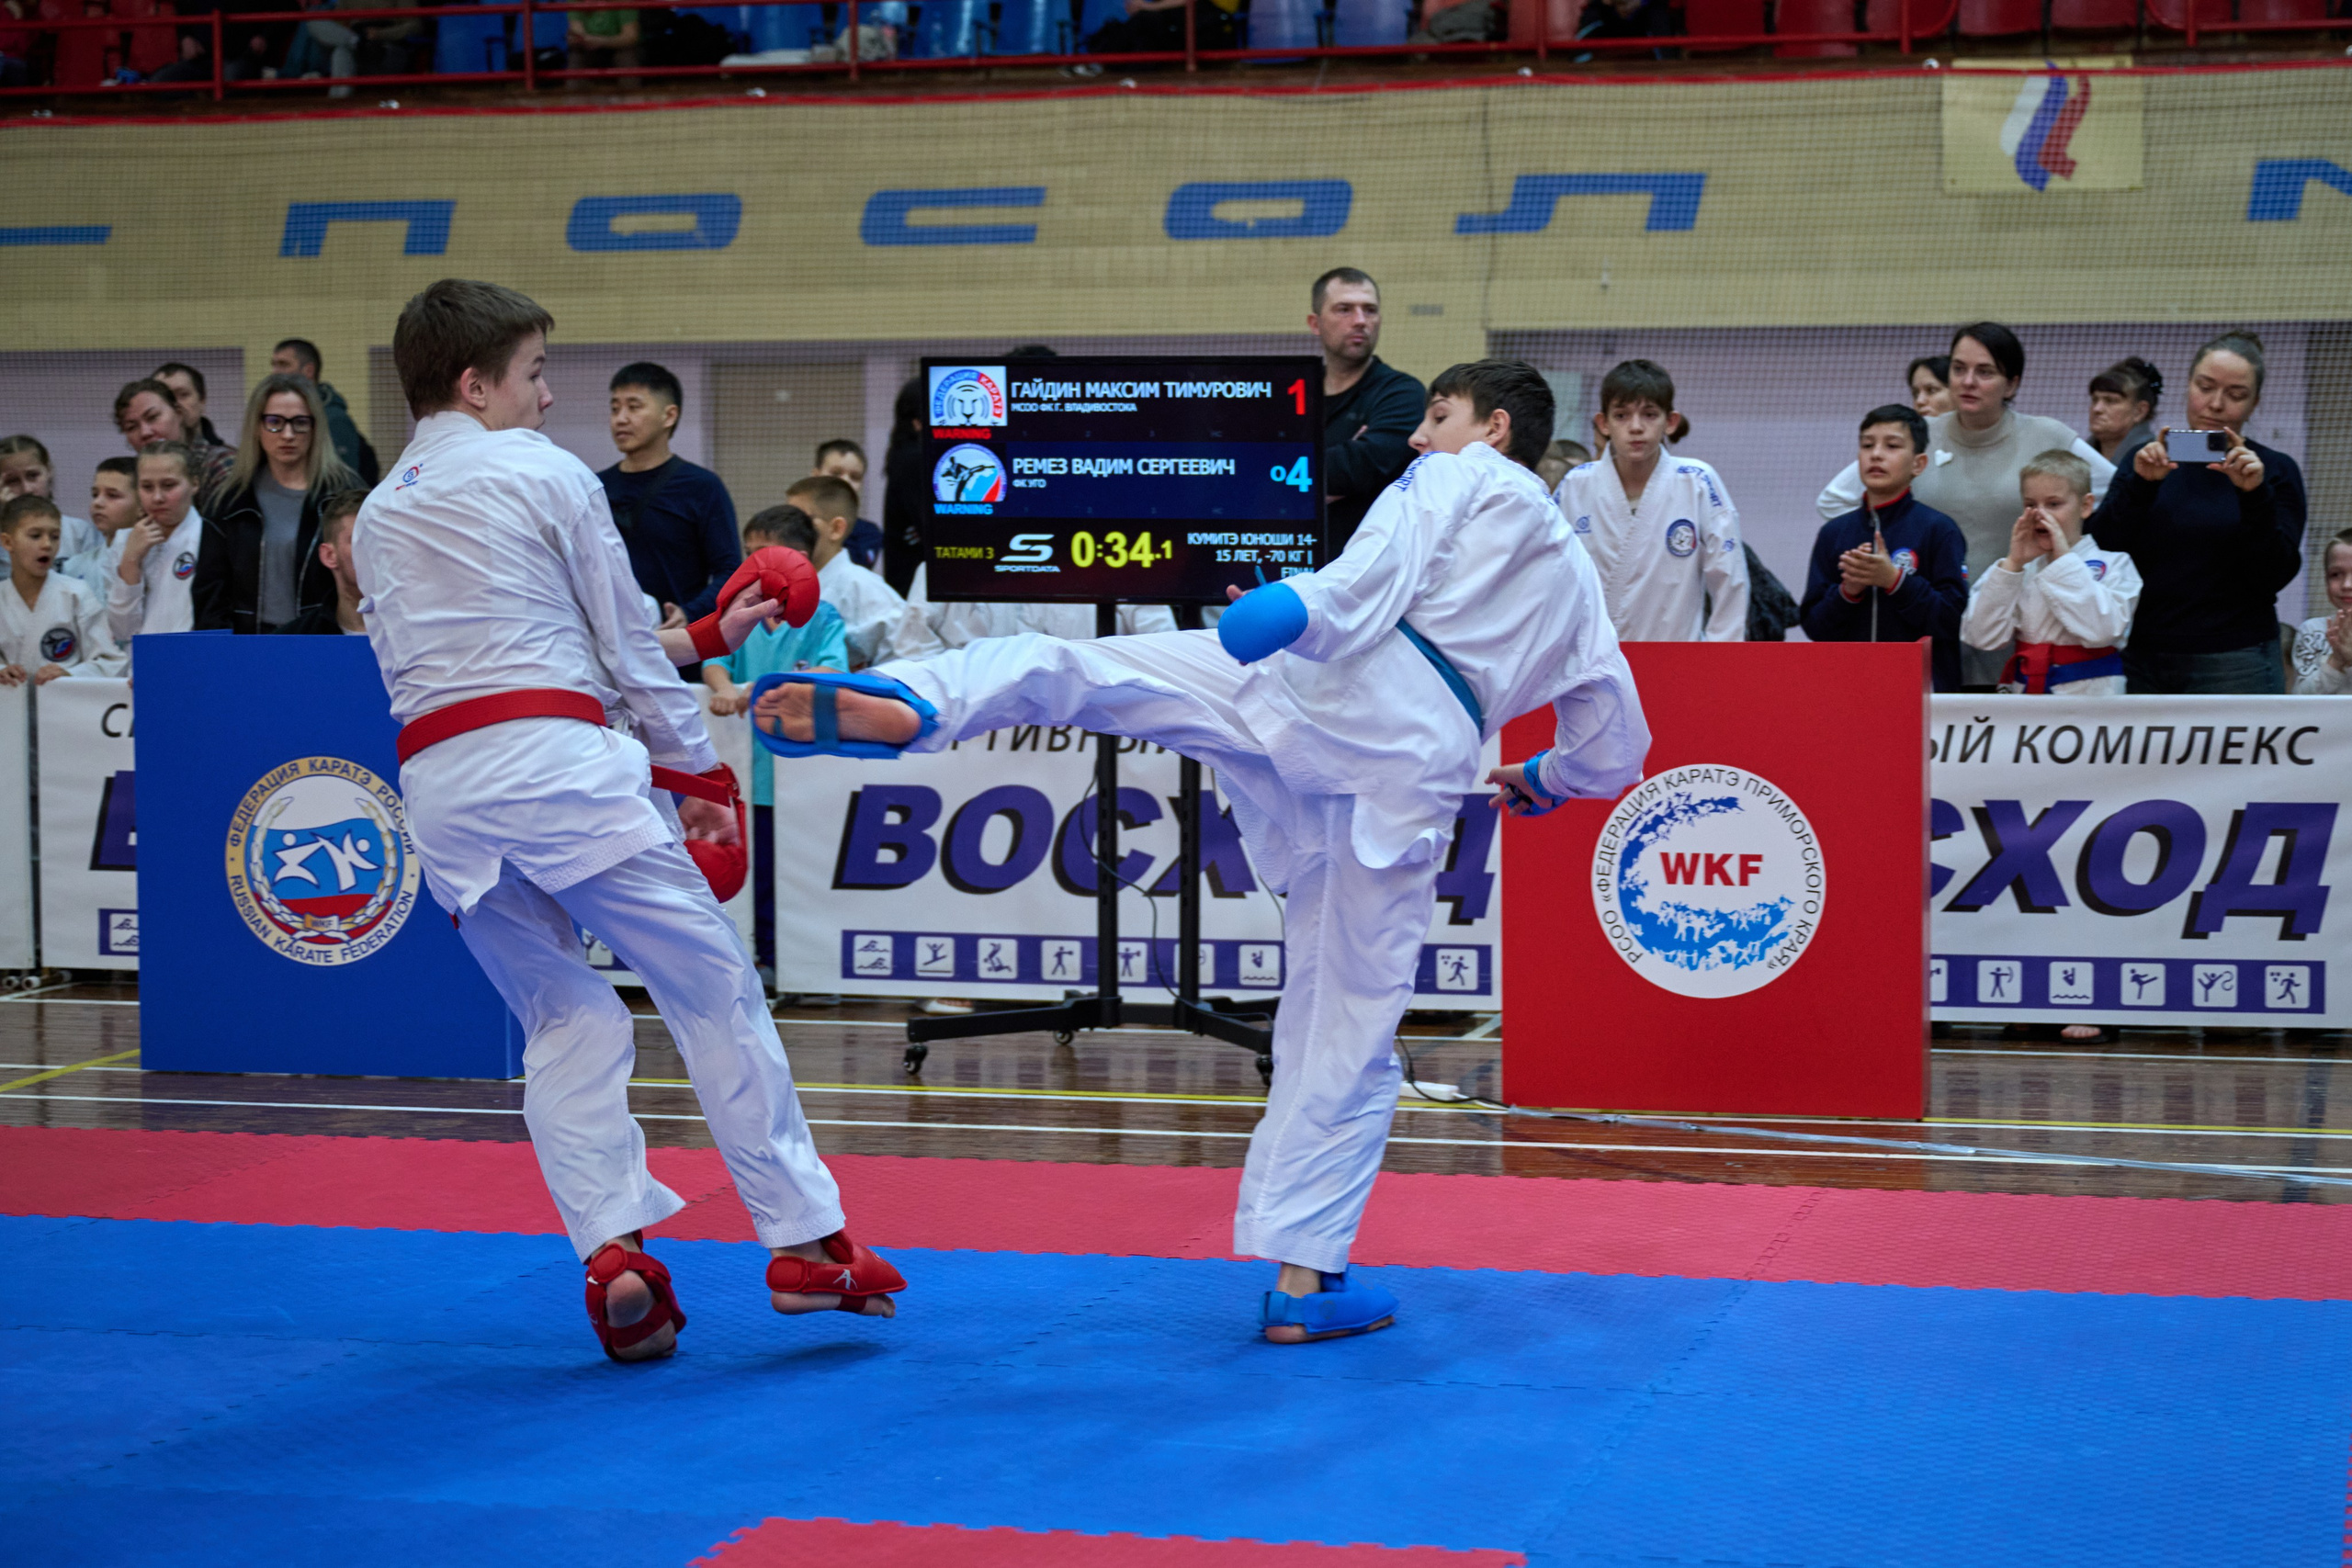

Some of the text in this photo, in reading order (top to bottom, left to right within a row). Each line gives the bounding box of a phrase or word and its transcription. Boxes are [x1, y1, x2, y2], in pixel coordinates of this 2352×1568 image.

[278, 173, 1707, 258] ПОСОЛ
[1011, 378, 1272, 400] ГАЙДИН МАКСИМ ТИМУРОВИЧ
[1287, 378, 1306, 415] 1
[1064, 402, 1137, 413] ВЛАДИВОСТОКА
[932, 428, 992, 439] WARNING
[1012, 458, 1236, 478] РЕМЕЗ ВАДИМ СЕРГЕЕВИЧ
[933, 503, 993, 514] WARNING
[934, 546, 994, 559] ТАТАМИ 3
[1187, 533, 1318, 546] КУМИТЭ ЮНОШИ 14-
[1215, 550, 1232, 562] 15
[1233, 549, 1262, 564] ЛЕТ,
[1264, 550, 1285, 562] -70
[1288, 550, 1304, 562] КГ
[2013, 725, 2321, 765] КОМПЛЕКС
[1663, 768, 1740, 791] КАРАТЭ
[230, 761, 300, 848] ФЕДЕРАЦИЯ
[309, 759, 372, 785] КАРАТЭ
[831, 784, 1499, 925] ВОСХД
[1596, 782, 1662, 903] «ФЕДЕРАЦИЯ
[1743, 777, 1824, 915] ПРИМОРСКОГО
[1659, 852, 1763, 886] WKF
[230, 874, 415, 964] RUSSIAN KARATE FEDERATION
[1602, 909, 1644, 964] РСОО
